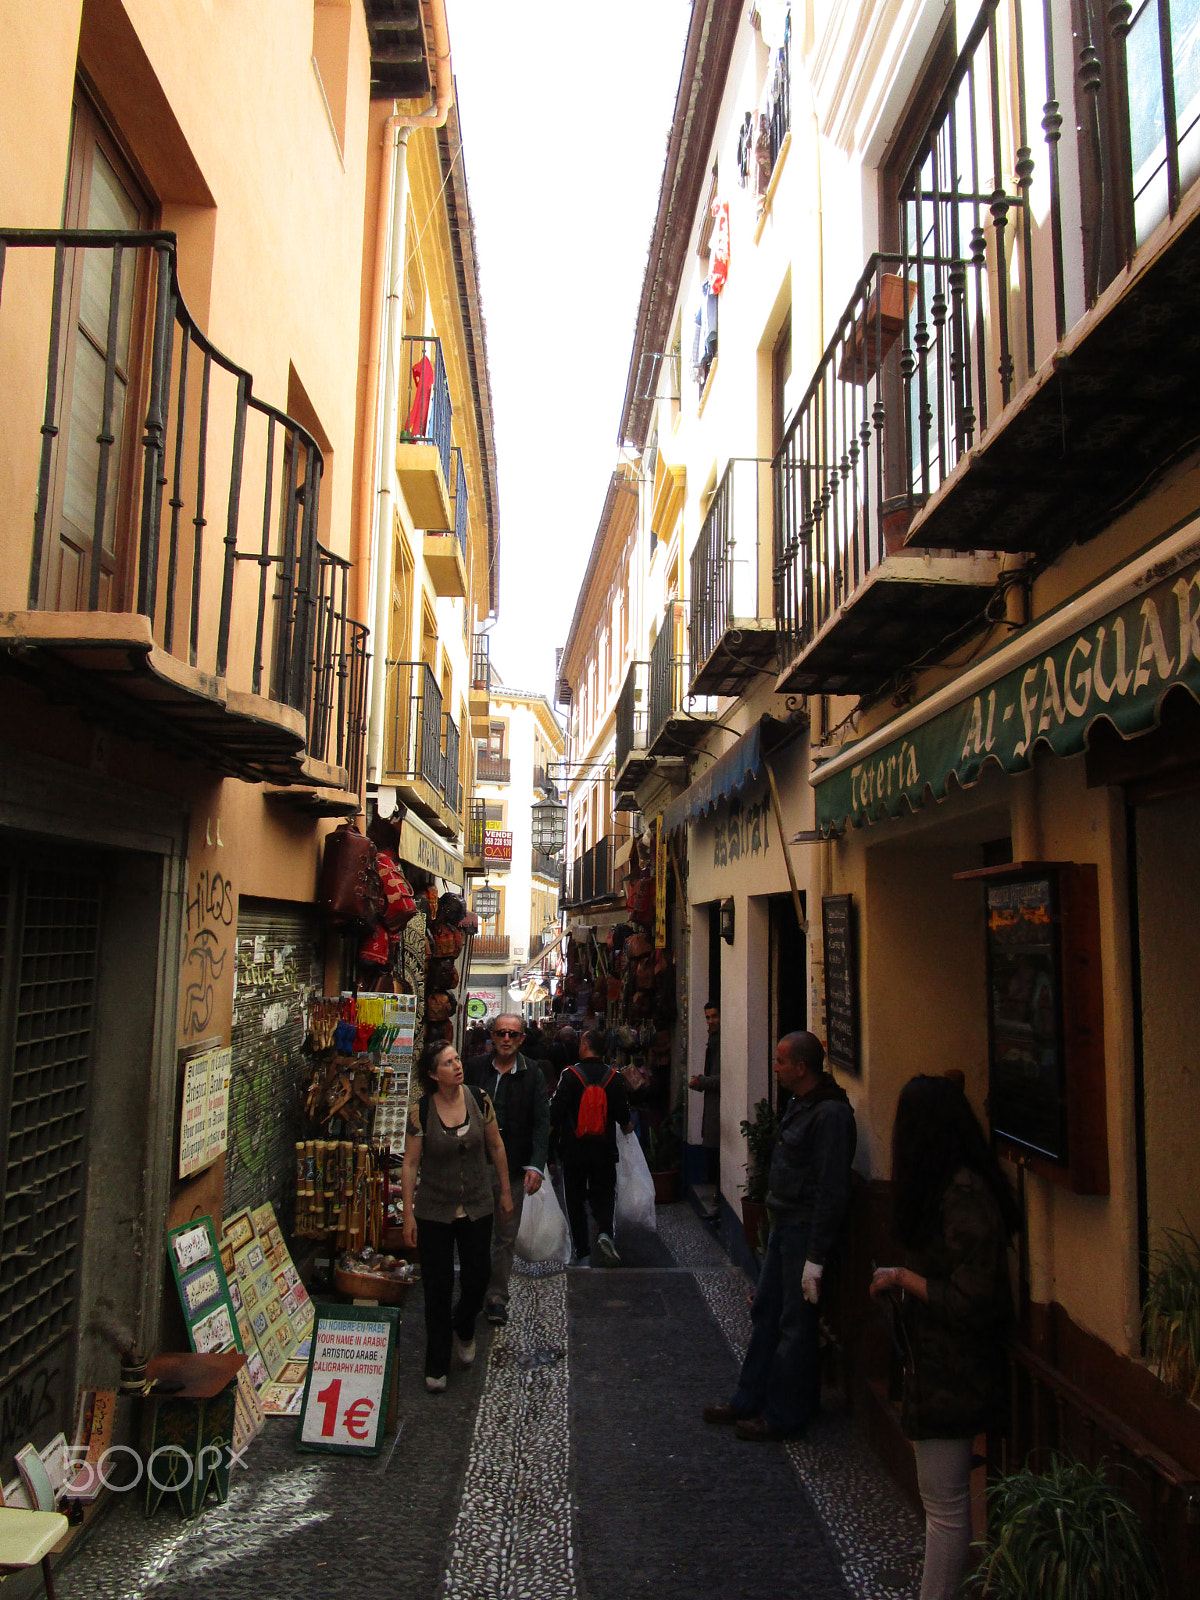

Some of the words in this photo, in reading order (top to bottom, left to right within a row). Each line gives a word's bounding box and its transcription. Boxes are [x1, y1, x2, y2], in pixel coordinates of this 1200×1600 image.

[486, 830, 512, 838] VENDE
[318, 1320, 328, 1330] SU
[328, 1321, 356, 1332] NOMBRE
[356, 1322, 366, 1332] EN
[317, 1334, 335, 1344] YOUR
[336, 1334, 354, 1346] NAME
[354, 1336, 362, 1346] IN
[362, 1336, 388, 1348] ARABIC
[321, 1348, 355, 1360] ARTISTICO
[356, 1350, 378, 1360] ARABE
[313, 1361, 354, 1374] CALIGRAPHY
[354, 1363, 384, 1375] ARTISTIC
